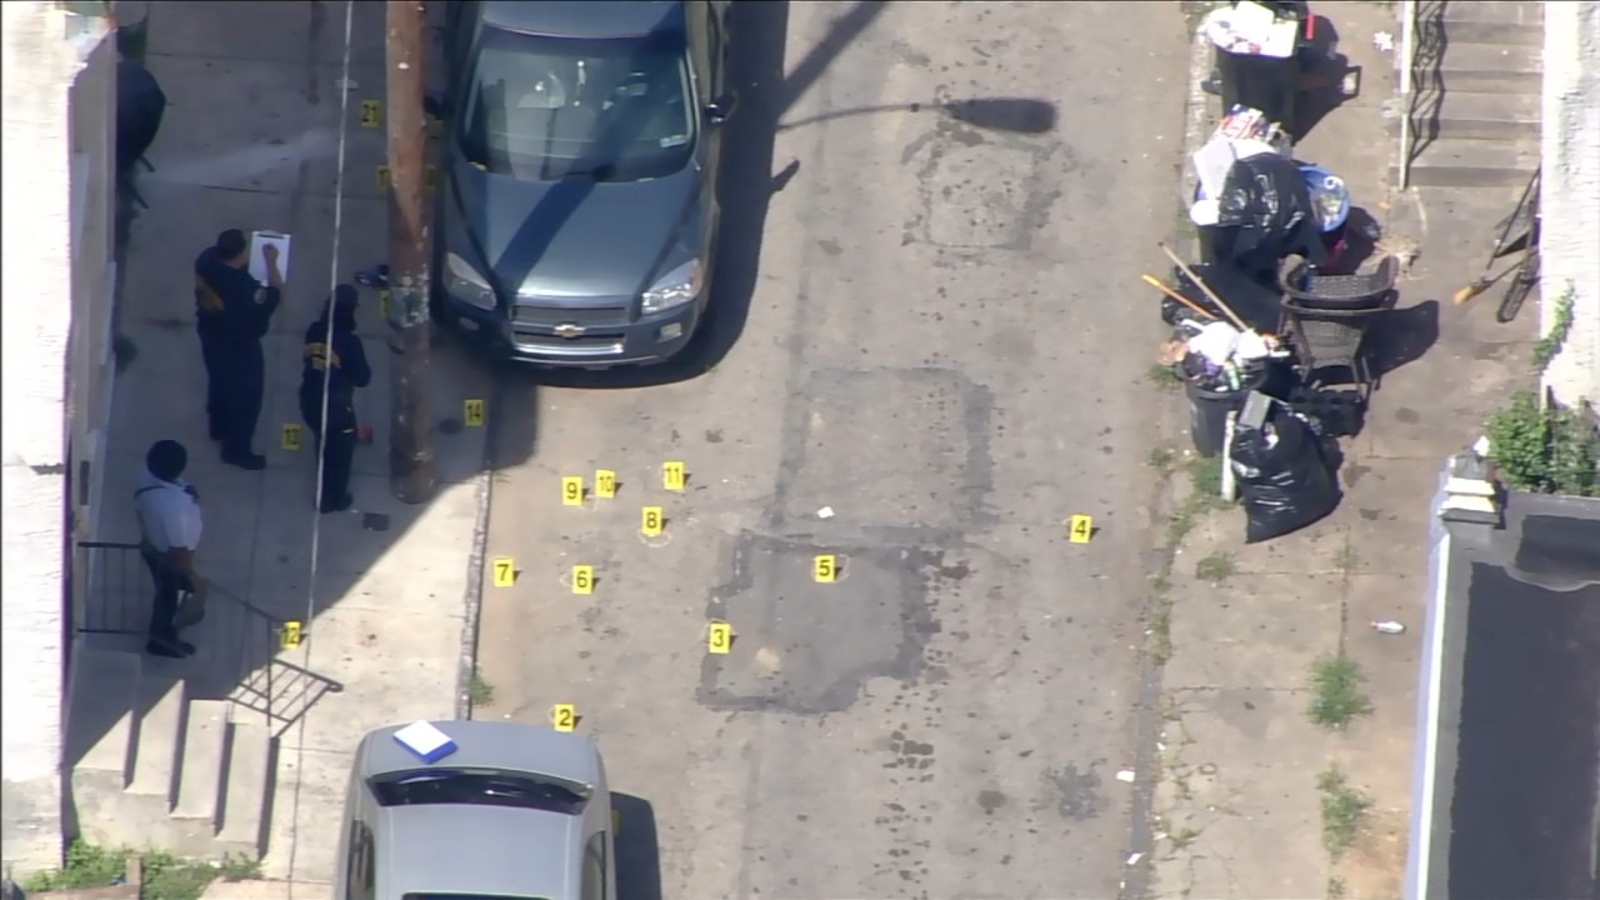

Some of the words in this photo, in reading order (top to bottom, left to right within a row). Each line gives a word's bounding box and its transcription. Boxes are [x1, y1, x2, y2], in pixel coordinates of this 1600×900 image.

[362, 104, 377, 122] 21
[468, 403, 481, 421] 14
[599, 475, 612, 492] 10
[666, 467, 680, 484] 11
[566, 482, 577, 500] 9
[646, 511, 658, 529] 8
[1075, 519, 1086, 538] 4
[496, 563, 510, 581] 7
[819, 559, 831, 577] 5
[577, 570, 588, 588] 6
[283, 627, 298, 644] 12
[713, 628, 724, 647] 3
[559, 708, 571, 726] 2
